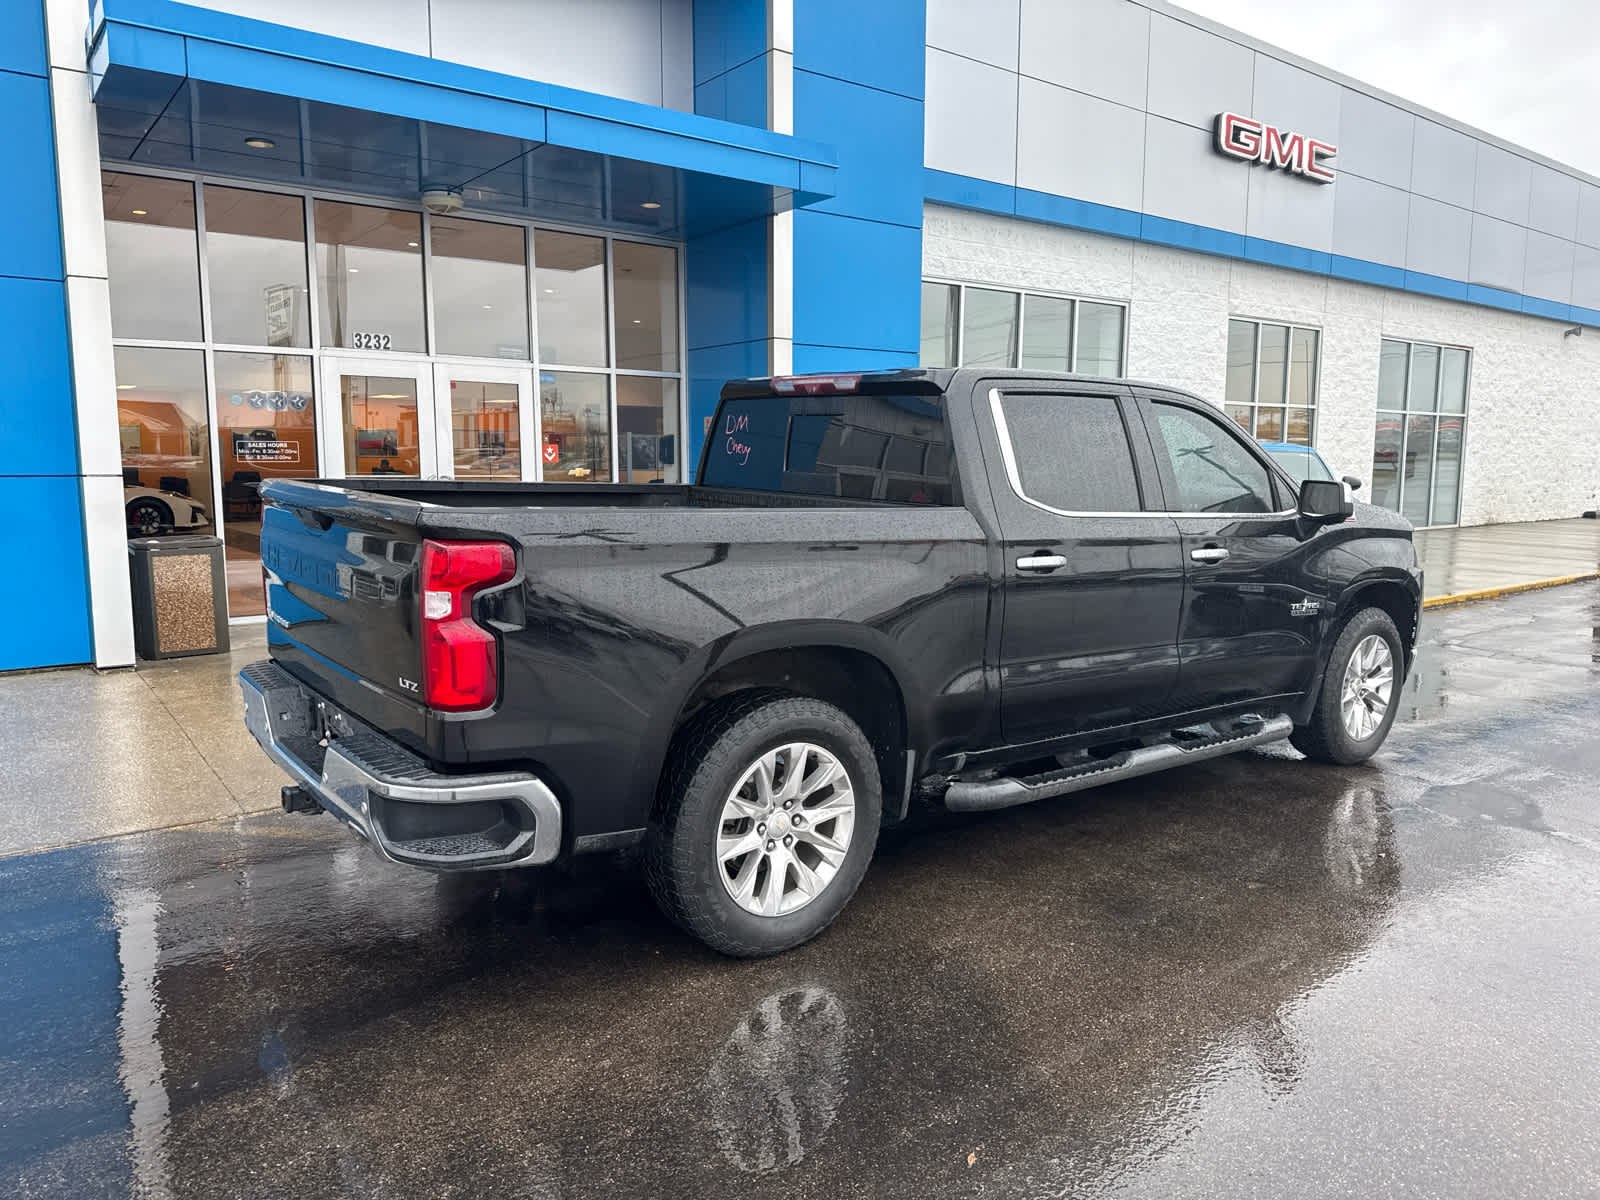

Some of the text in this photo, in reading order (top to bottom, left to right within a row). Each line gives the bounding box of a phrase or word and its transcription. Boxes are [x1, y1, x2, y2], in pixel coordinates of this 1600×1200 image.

[1218, 111, 1337, 184] GMC
[354, 332, 391, 350] 3232
[725, 415, 749, 434] DM
[726, 436, 751, 466] Chevy
[399, 676, 418, 693] LTZ
